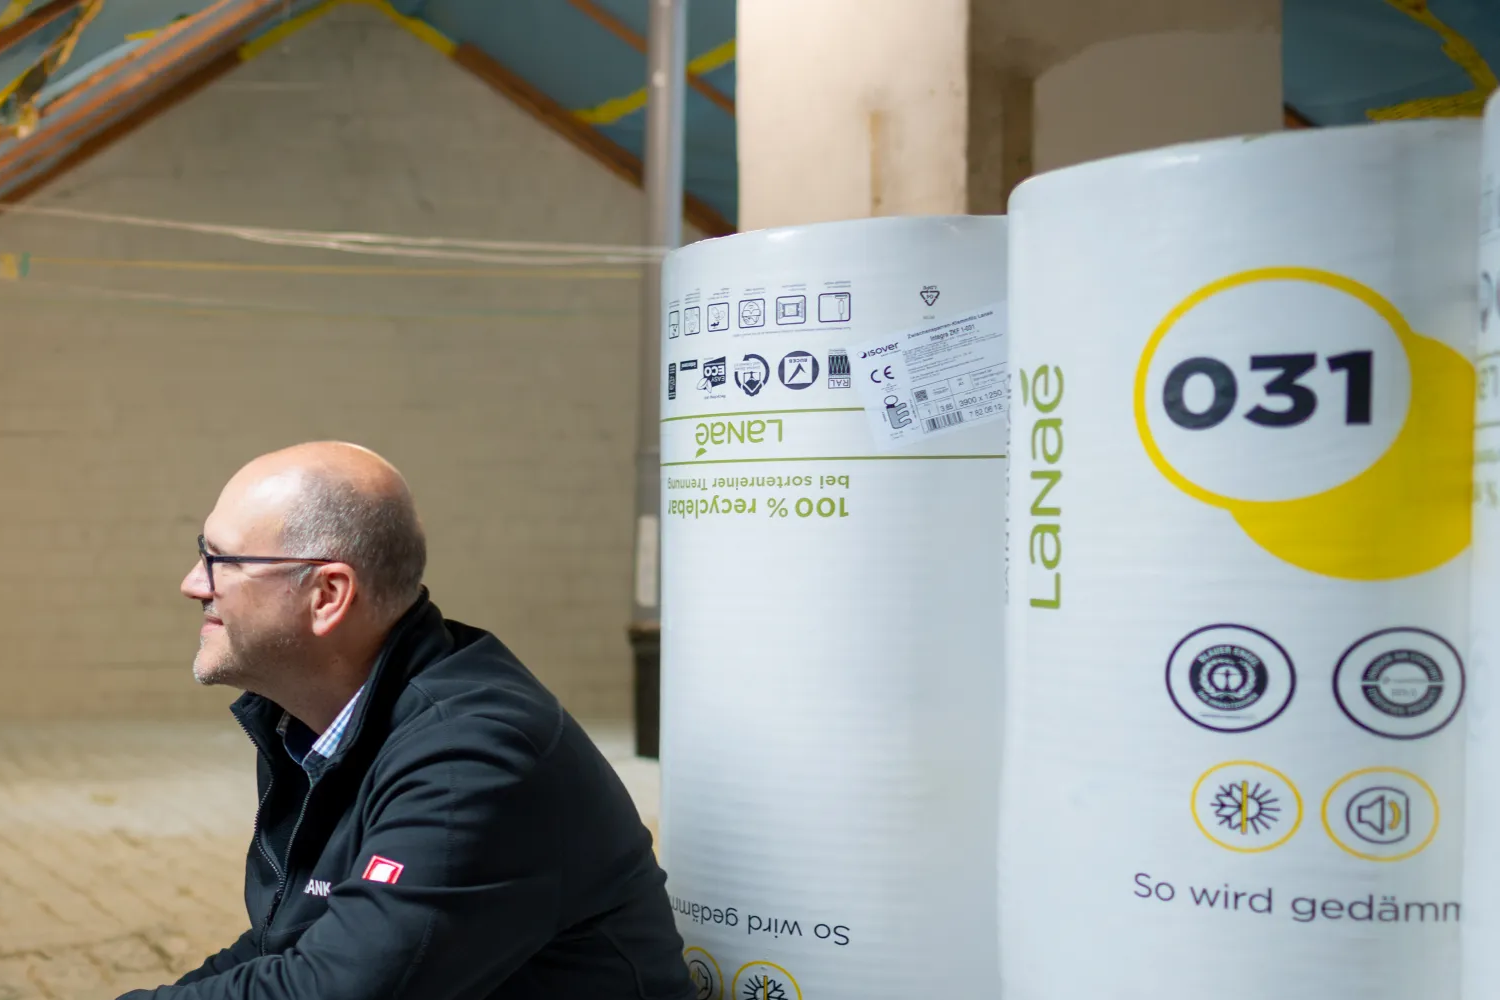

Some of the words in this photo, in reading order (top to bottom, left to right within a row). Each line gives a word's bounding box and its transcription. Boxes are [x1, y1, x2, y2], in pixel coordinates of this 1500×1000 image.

[704, 365, 725, 377] ECO
[831, 379, 848, 387] RAL
[1162, 350, 1374, 431] 031
[959, 396, 977, 407] 3900
[984, 389, 1002, 399] 1250
[668, 477, 707, 490] Trennung
[712, 475, 812, 490] sortenreiner
[820, 475, 850, 489] bei
[668, 495, 756, 518] recyclebar
[767, 498, 788, 518] %
[795, 497, 849, 518] 100
[1133, 873, 1175, 902] So
[1190, 883, 1273, 914] wird
[748, 915, 803, 938] wird
[814, 924, 850, 945] So
